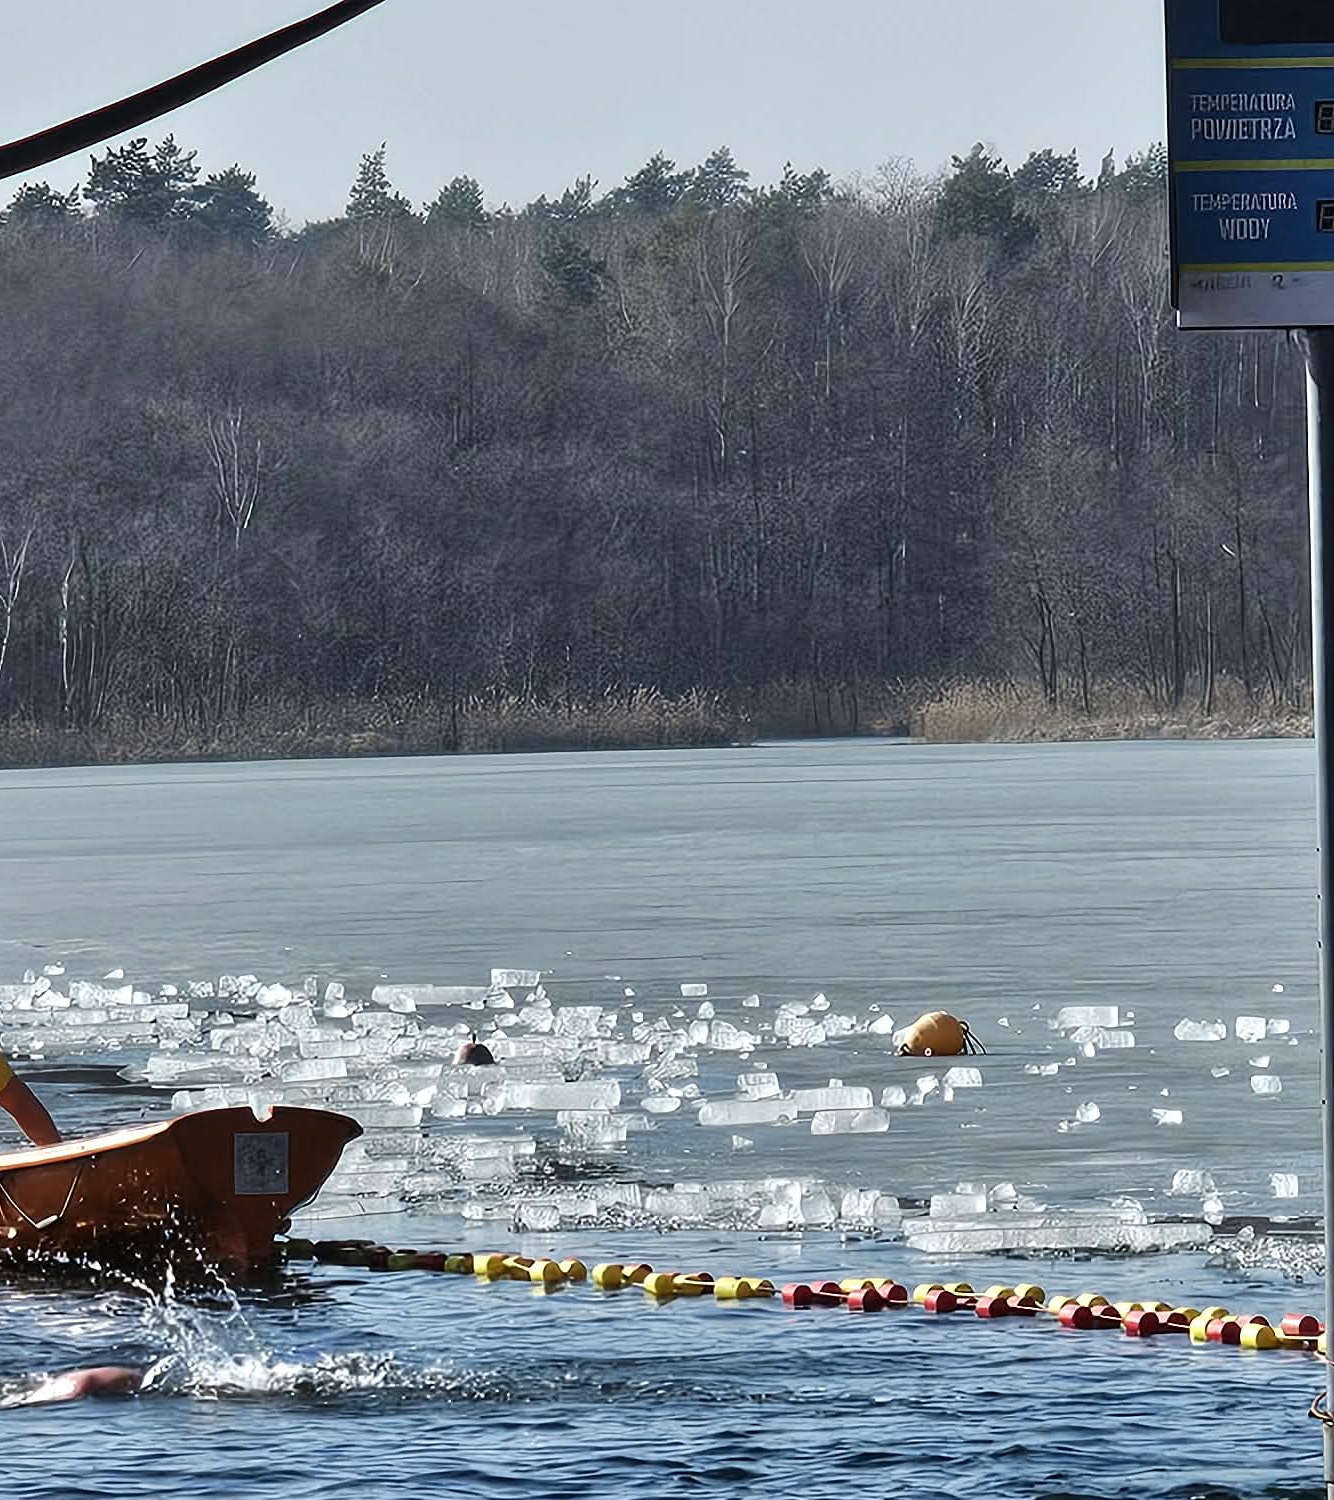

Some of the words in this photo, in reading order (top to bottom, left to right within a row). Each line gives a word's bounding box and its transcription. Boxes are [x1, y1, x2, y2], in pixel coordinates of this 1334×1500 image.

[1190, 94, 1296, 111] TEMPERATURA
[1191, 117, 1297, 140] POWIETRZA
[1192, 193, 1298, 211] TEMPERATURA
[1219, 218, 1270, 240] WODY
